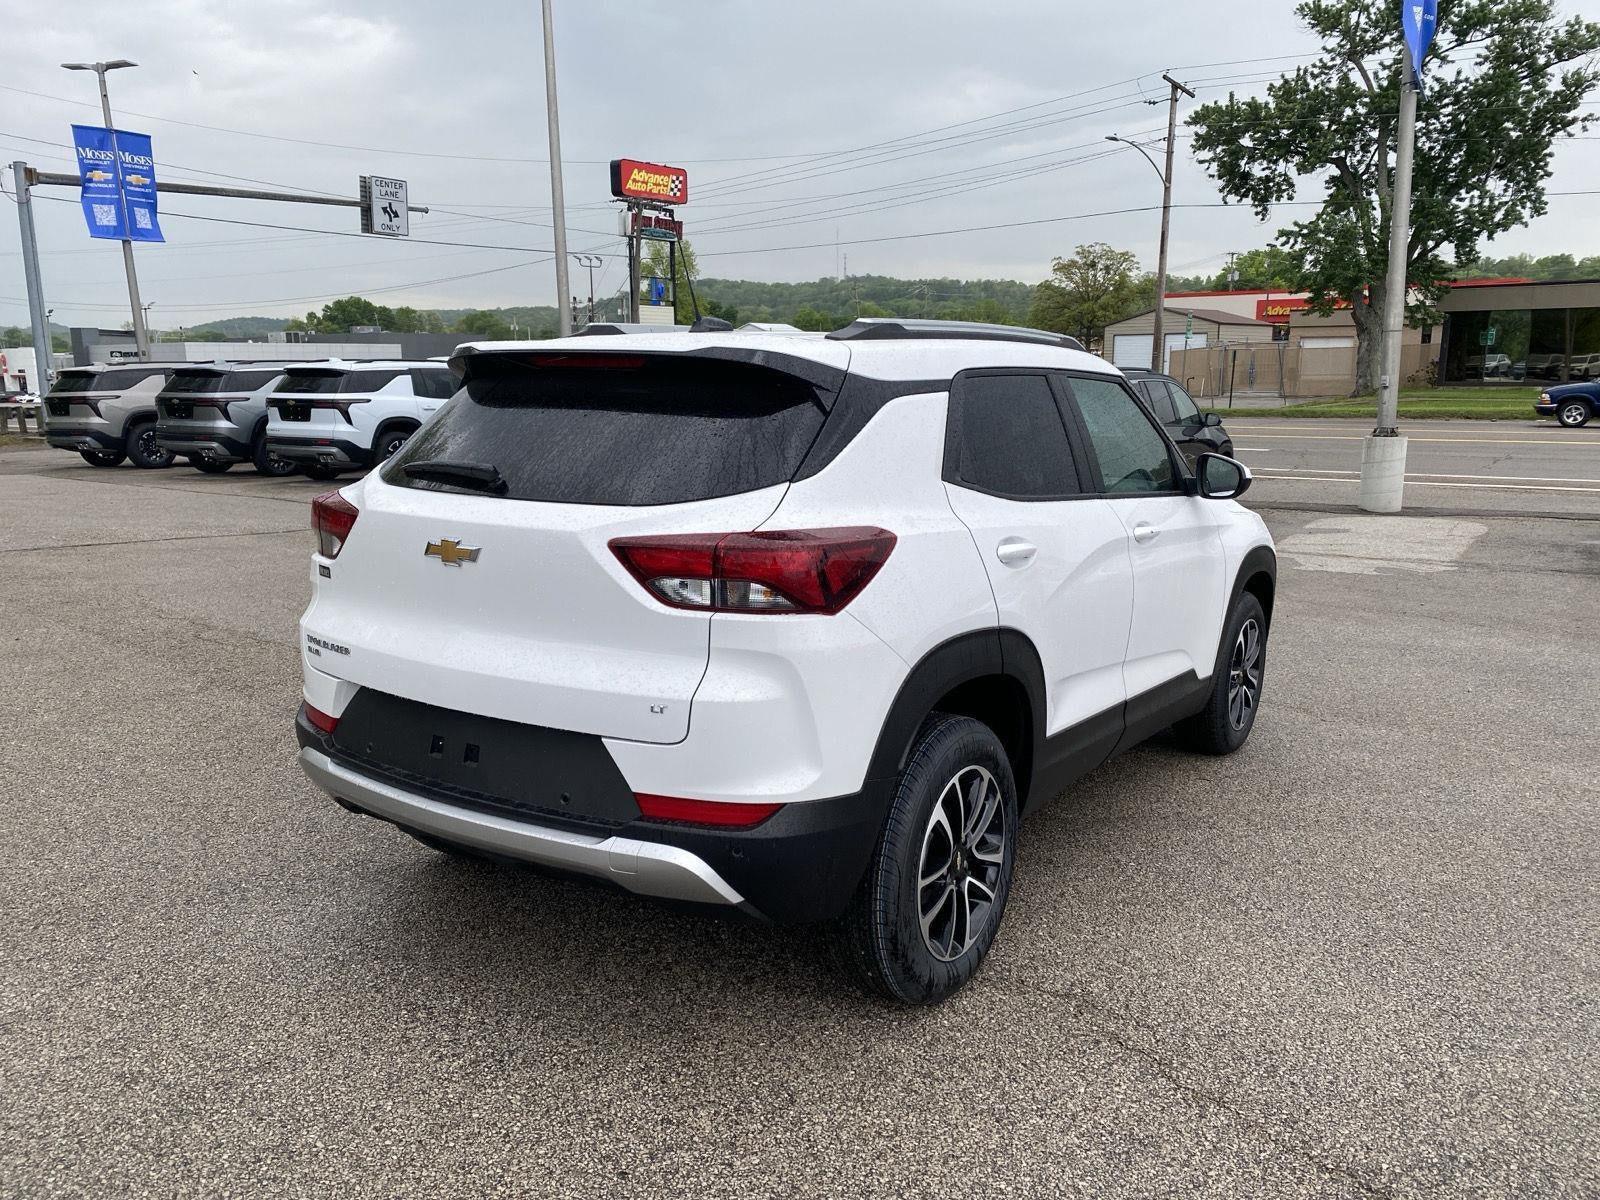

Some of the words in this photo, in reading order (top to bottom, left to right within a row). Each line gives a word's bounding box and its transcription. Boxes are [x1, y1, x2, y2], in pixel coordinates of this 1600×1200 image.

[77, 146, 114, 160] MOSES
[119, 151, 152, 166] MOSES
[630, 168, 669, 185] Advance
[374, 179, 404, 190] CENTER
[625, 180, 647, 191] Auto
[647, 181, 668, 194] Parts
[379, 189, 399, 199] LANE
[381, 223, 401, 232] ONLY
[1263, 305, 1290, 316] Adva
[650, 703, 668, 714] LT
